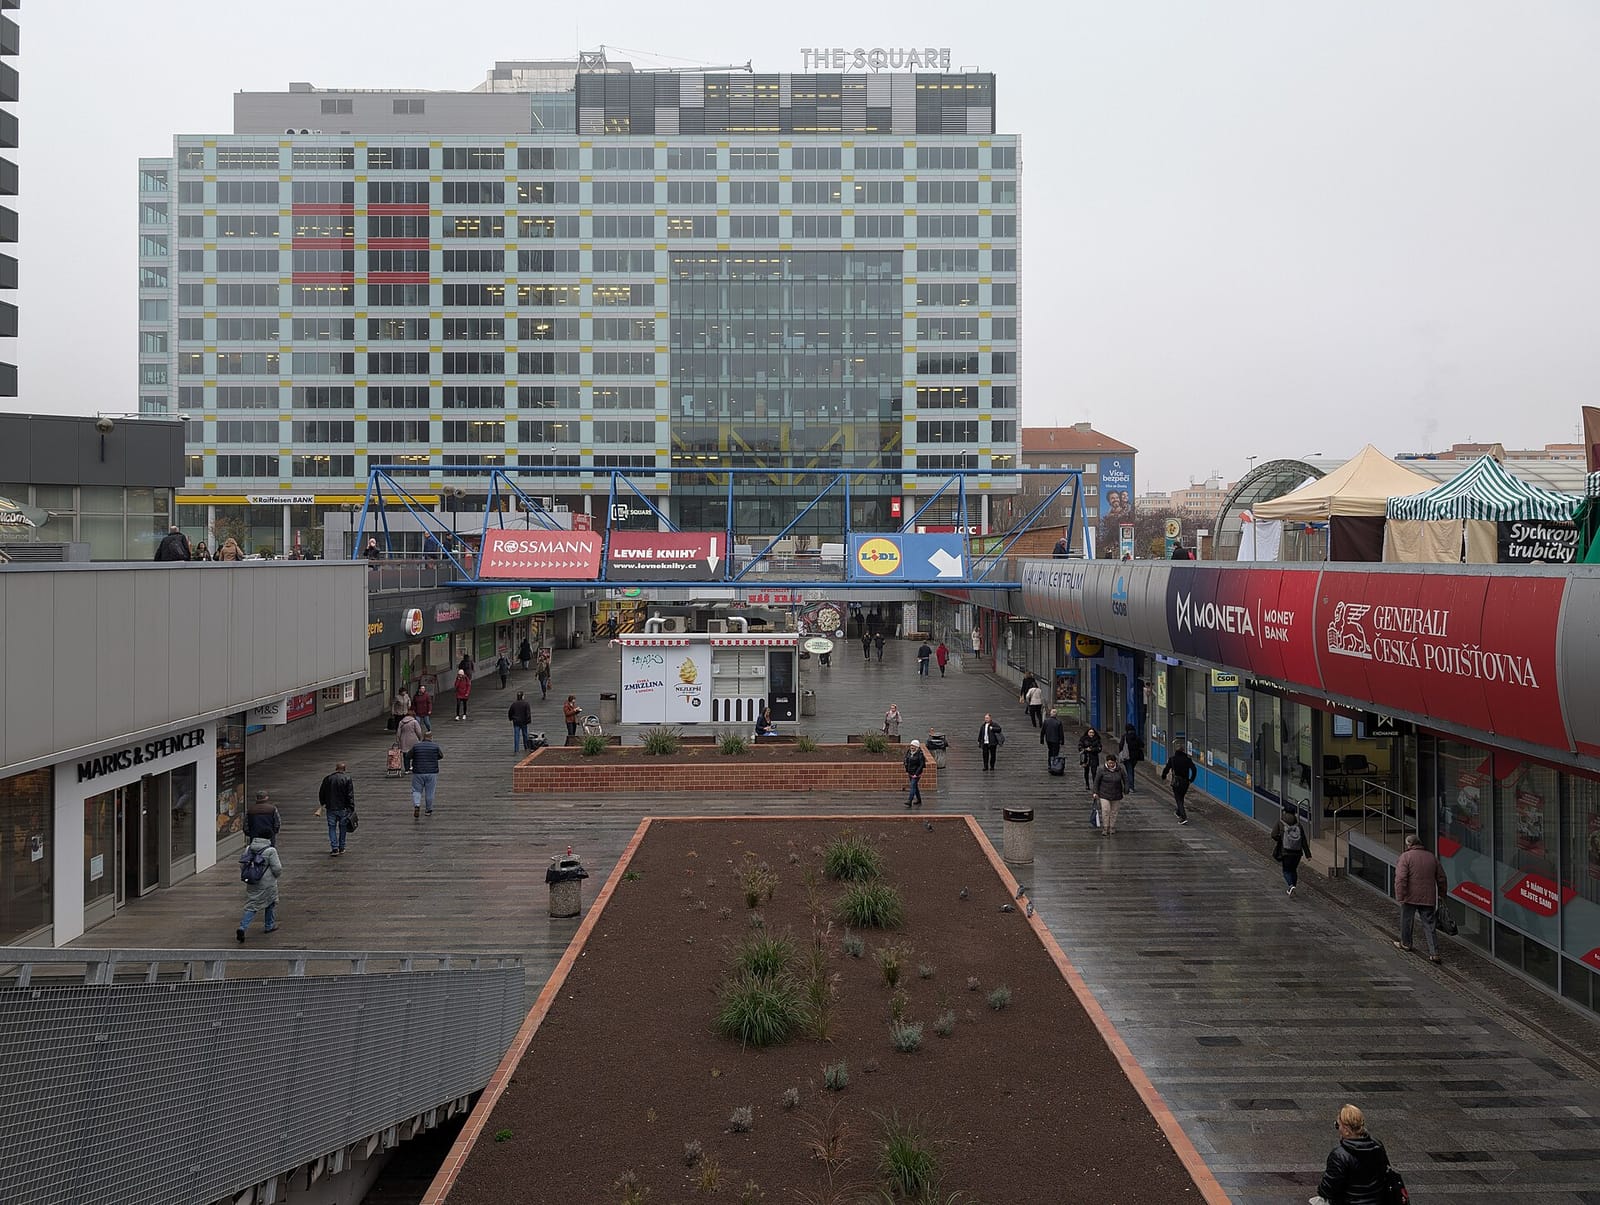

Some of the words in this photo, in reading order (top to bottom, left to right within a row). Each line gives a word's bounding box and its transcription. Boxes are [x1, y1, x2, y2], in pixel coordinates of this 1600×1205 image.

[800, 47, 844, 69] THE
[853, 47, 950, 69] SQUARE
[258, 496, 292, 504] Raiffeisen
[292, 496, 314, 504] BANK
[493, 540, 593, 554] ROSSMANN
[614, 547, 653, 558] LEVNÉ
[656, 549, 697, 559] KNIHY
[861, 549, 898, 562] LIDL
[1508, 542, 1575, 564] trubičky
[613, 562, 697, 571] www.levneknihy.cz
[1048, 571, 1084, 591] CENTRUM
[1194, 602, 1255, 636] MONETA
[1264, 609, 1295, 626] MONEY
[1373, 605, 1449, 637] GENERALI
[1264, 625, 1289, 642] BANK
[1373, 632, 1421, 669] ČESKÁ
[1424, 643, 1540, 689] POJIŠŤOVNA
[254, 704, 279, 715] M&S
[77, 749, 132, 784] MARKS
[133, 746, 144, 766] &
[144, 728, 205, 762] SPENCER
